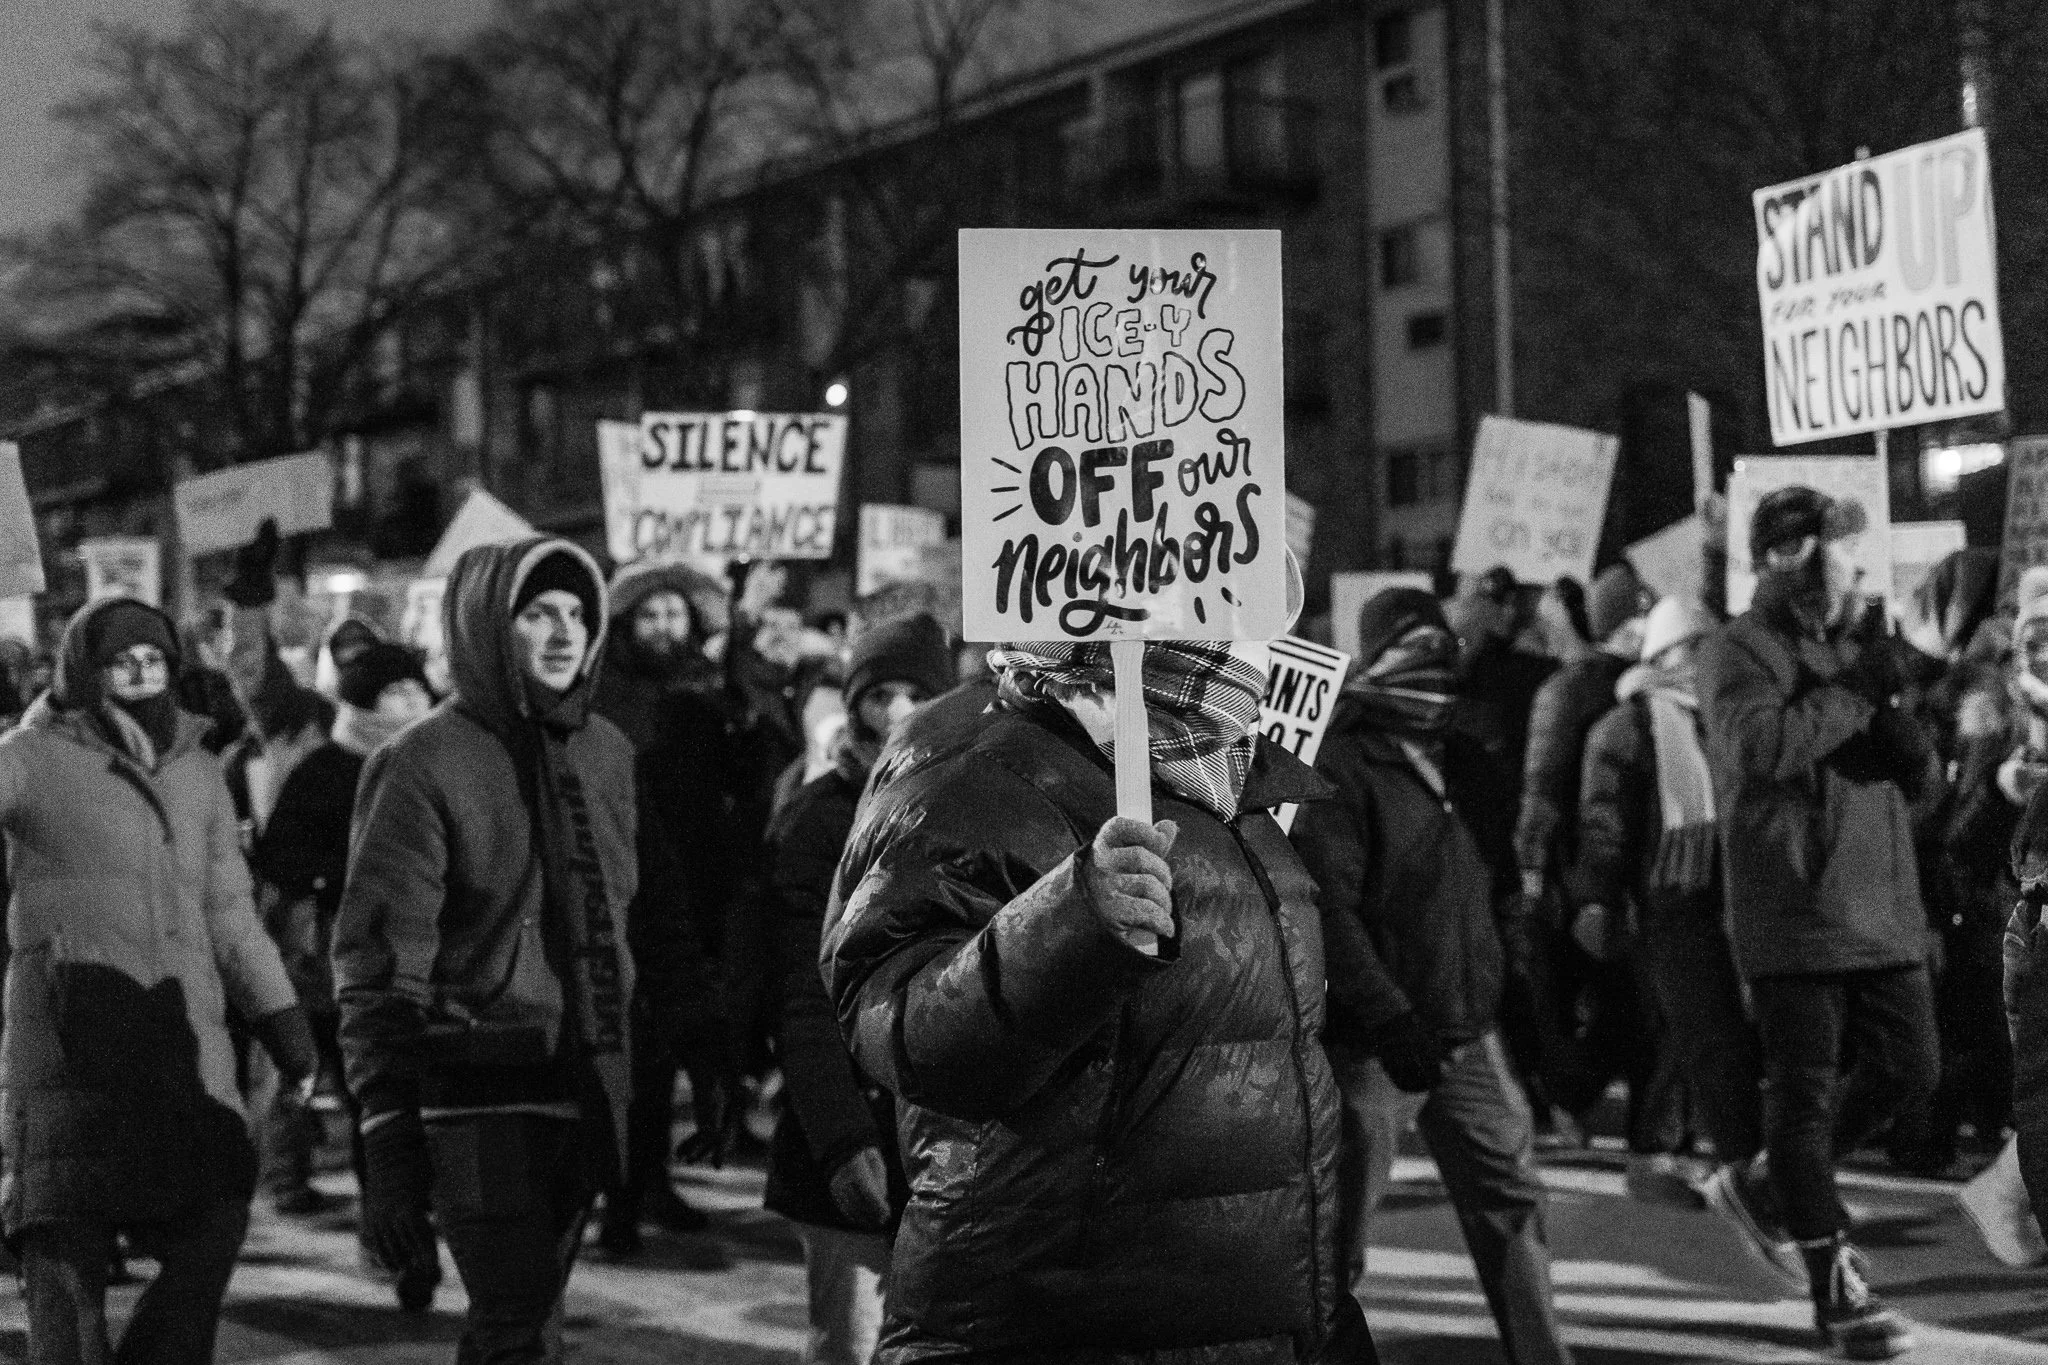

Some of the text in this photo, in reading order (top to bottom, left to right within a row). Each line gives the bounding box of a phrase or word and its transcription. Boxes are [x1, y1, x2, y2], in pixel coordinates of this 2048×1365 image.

[1763, 143, 1978, 292] STAND UP
[1006, 247, 1218, 356] get your
[1006, 328, 1246, 450] HANDS
[1771, 299, 1989, 434] NEIGHBORS
[641, 419, 832, 474] SILENCE
[1029, 438, 1175, 528] OFF
[1178, 427, 1252, 497] our
